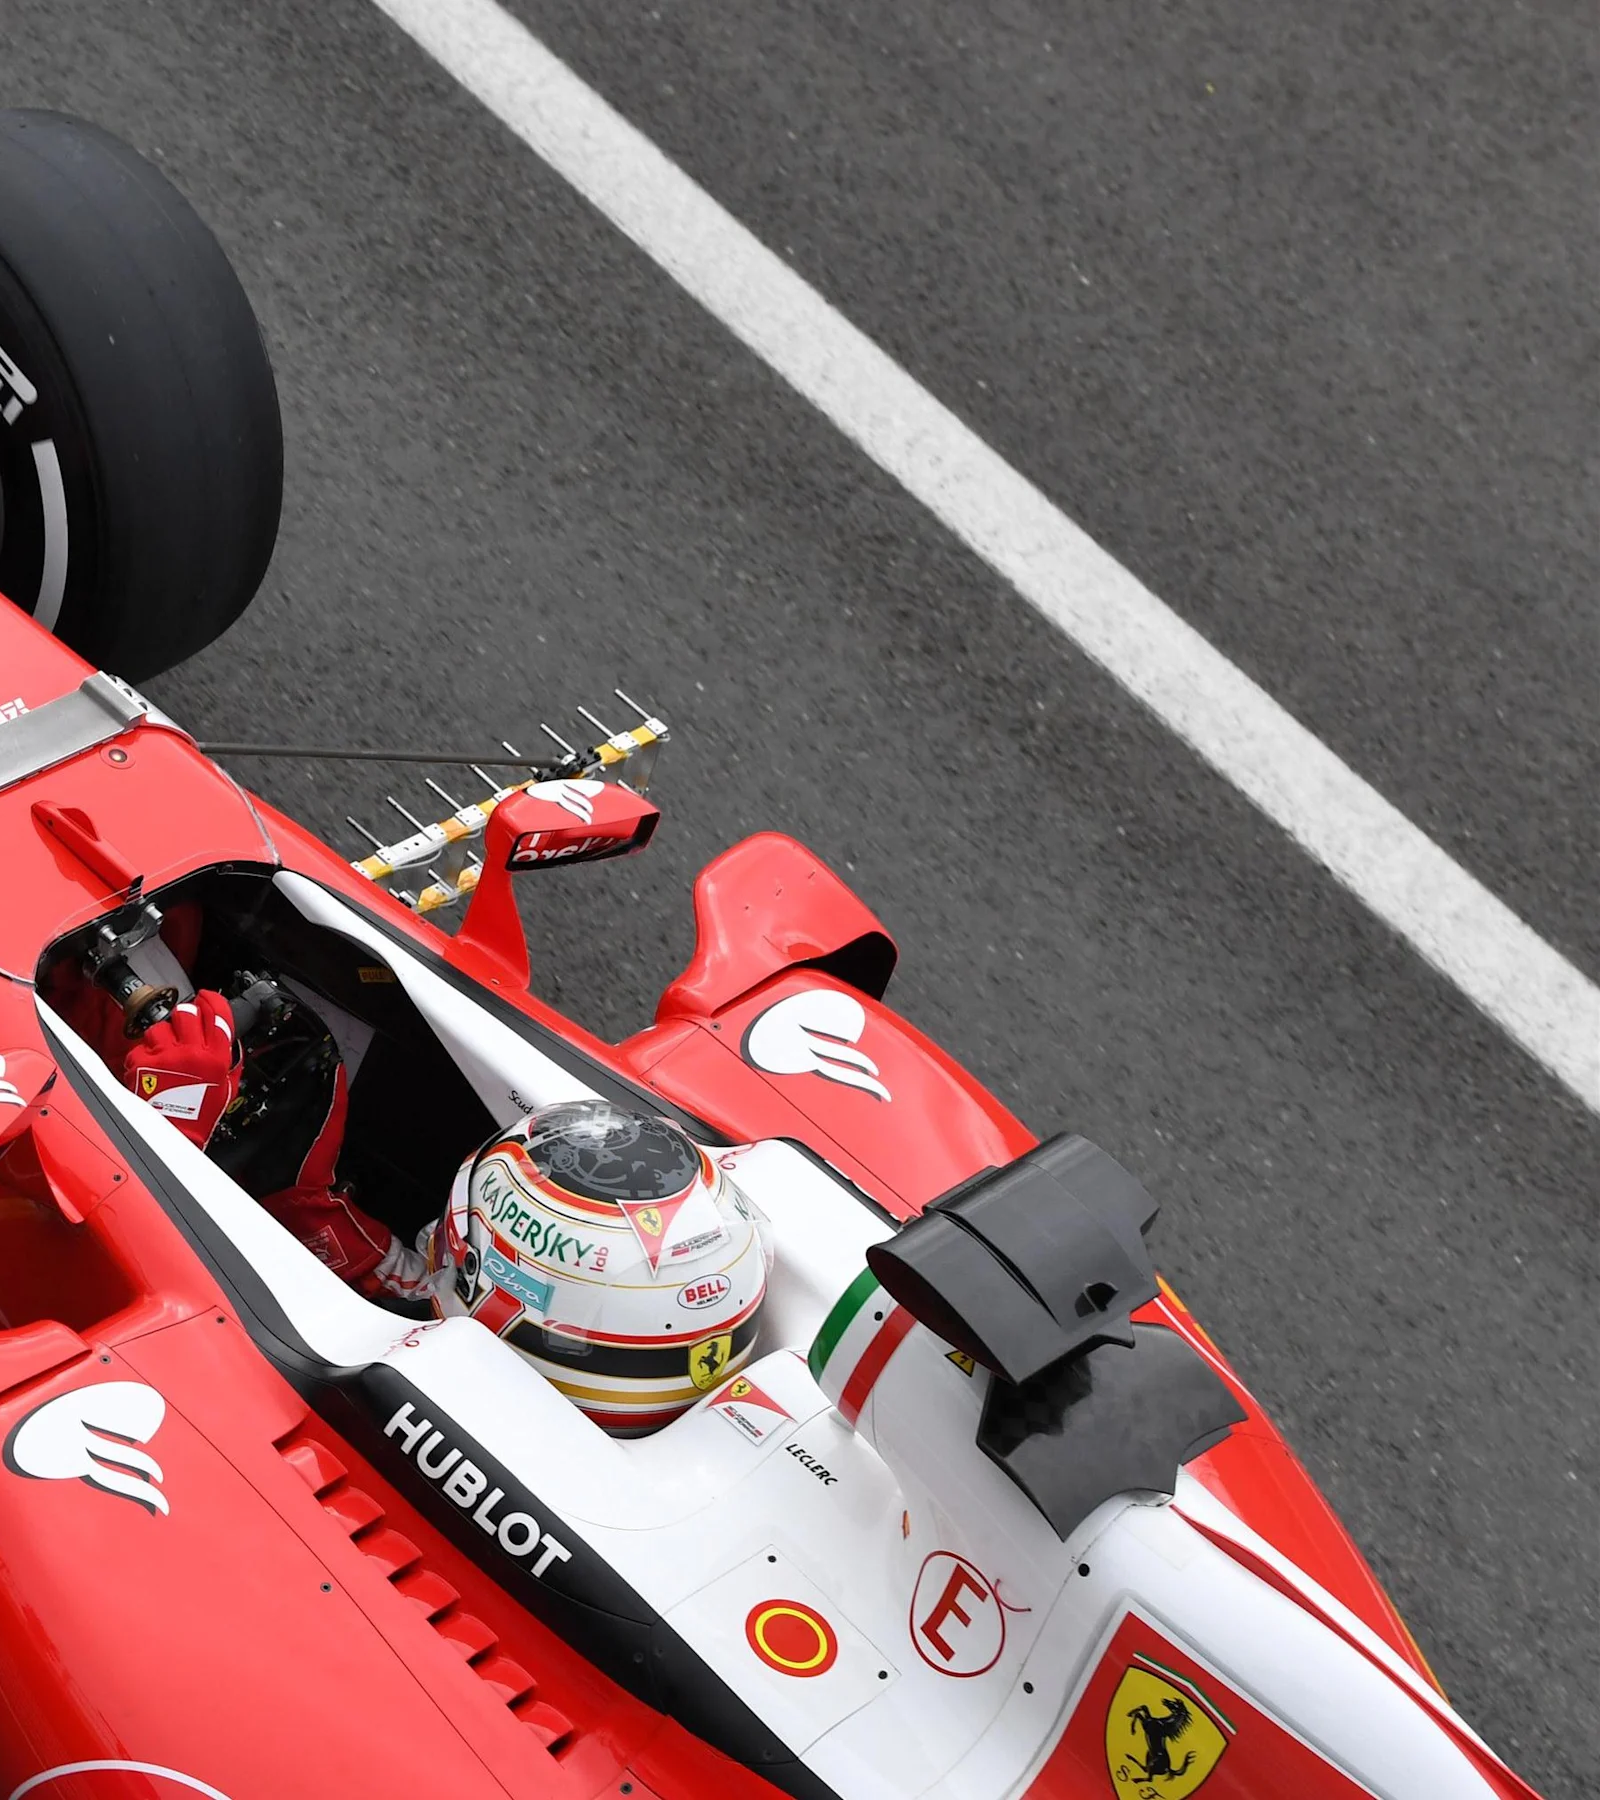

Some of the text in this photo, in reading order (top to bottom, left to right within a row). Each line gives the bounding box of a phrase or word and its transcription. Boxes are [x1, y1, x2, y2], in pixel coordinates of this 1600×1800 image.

[508, 1089, 533, 1115] Scud
[479, 1171, 609, 1272] KASPERSKY lab
[483, 1255, 539, 1302] Riva
[685, 1279, 726, 1303] BELL
[785, 1443, 838, 1486] LECLERC
[383, 1401, 572, 1579] HUBLOT
[920, 1563, 988, 1662] E
